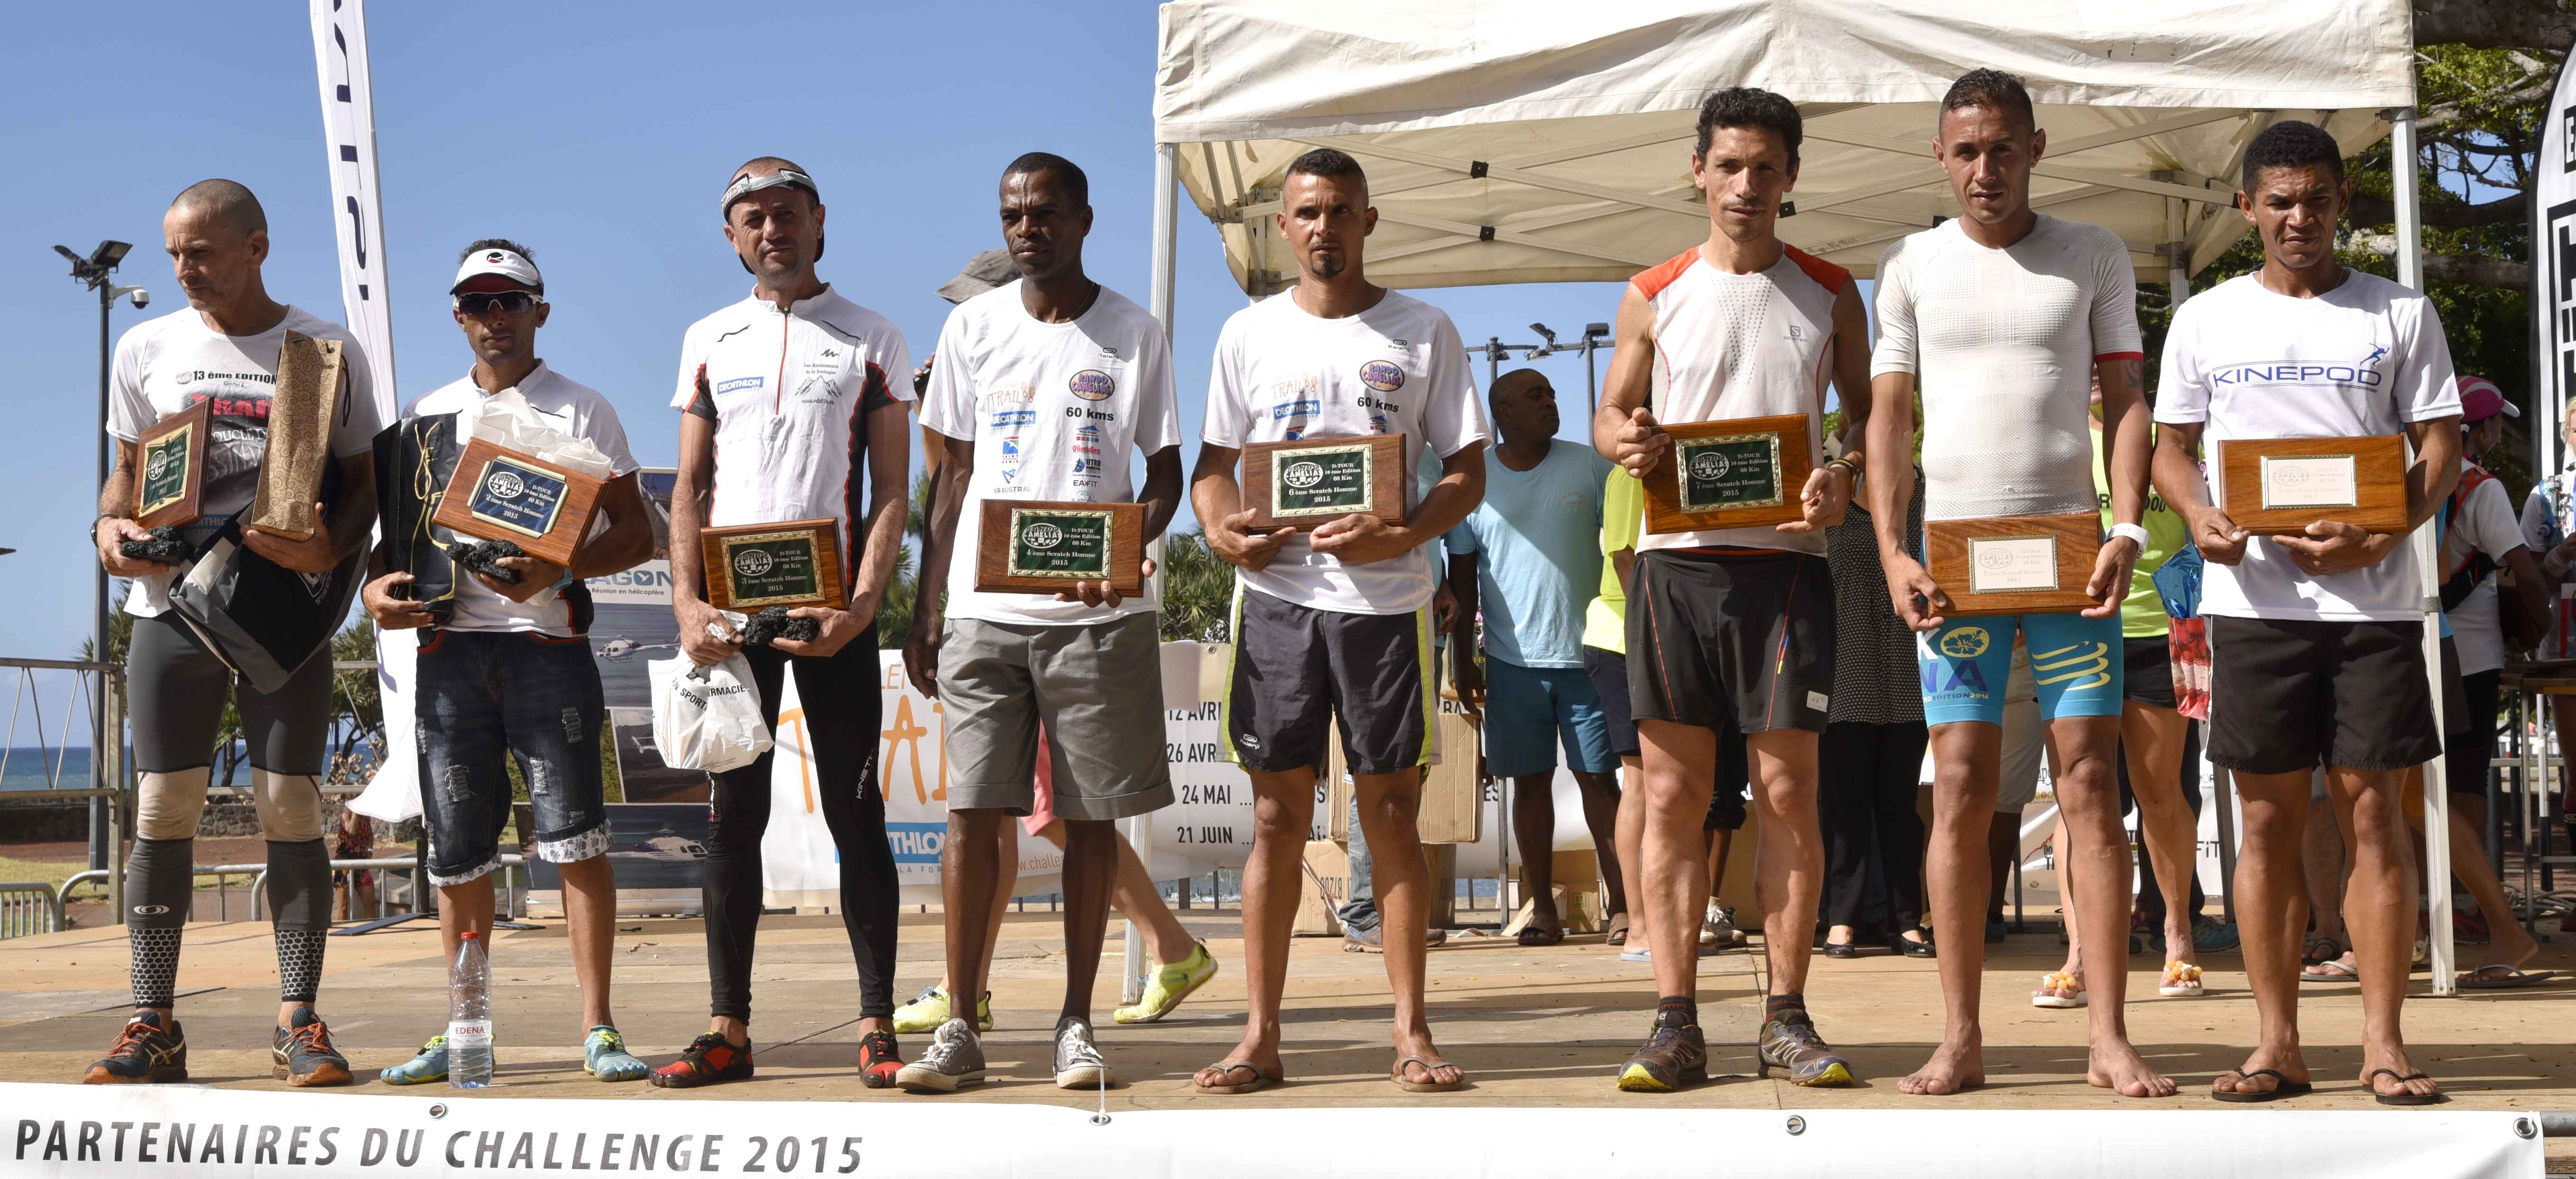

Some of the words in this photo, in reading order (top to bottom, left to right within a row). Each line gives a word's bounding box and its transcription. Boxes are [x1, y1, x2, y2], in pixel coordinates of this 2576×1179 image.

[193, 370, 205, 381] 13
[2213, 366, 2381, 387] KINEPOD
[1357, 397, 1371, 407] 60
[1375, 399, 1399, 412] kms
[1066, 407, 1082, 417] 60
[1087, 409, 1114, 420] kms
[211, 429, 254, 442] OUCLE
[532, 485, 551, 495] D-TOUR
[1696, 482, 1700, 490] 7
[539, 492, 555, 502] Edition
[503, 500, 523, 512] Scratch
[523, 507, 544, 519] Homme
[503, 510, 519, 519] 2015
[736, 557, 771, 566] CAMELIAS
[709, 685, 746, 697] RMACIE
[1188, 702, 1221, 721] AVRI
[1240, 738, 1260, 750] Kalenji
[1167, 743, 1183, 762] 26
[1188, 743, 1217, 762] AVR
[1182, 785, 1199, 804] 24
[1204, 785, 1230, 804] MAI
[1177, 826, 1192, 843] 21
[1200, 826, 1233, 844] JUIN
[16, 1119, 340, 1166] PARTENAIRES
[360, 1127, 424, 1167] DU
[445, 1130, 724, 1173] CHALLENGE
[743, 1135, 863, 1174] 2015
